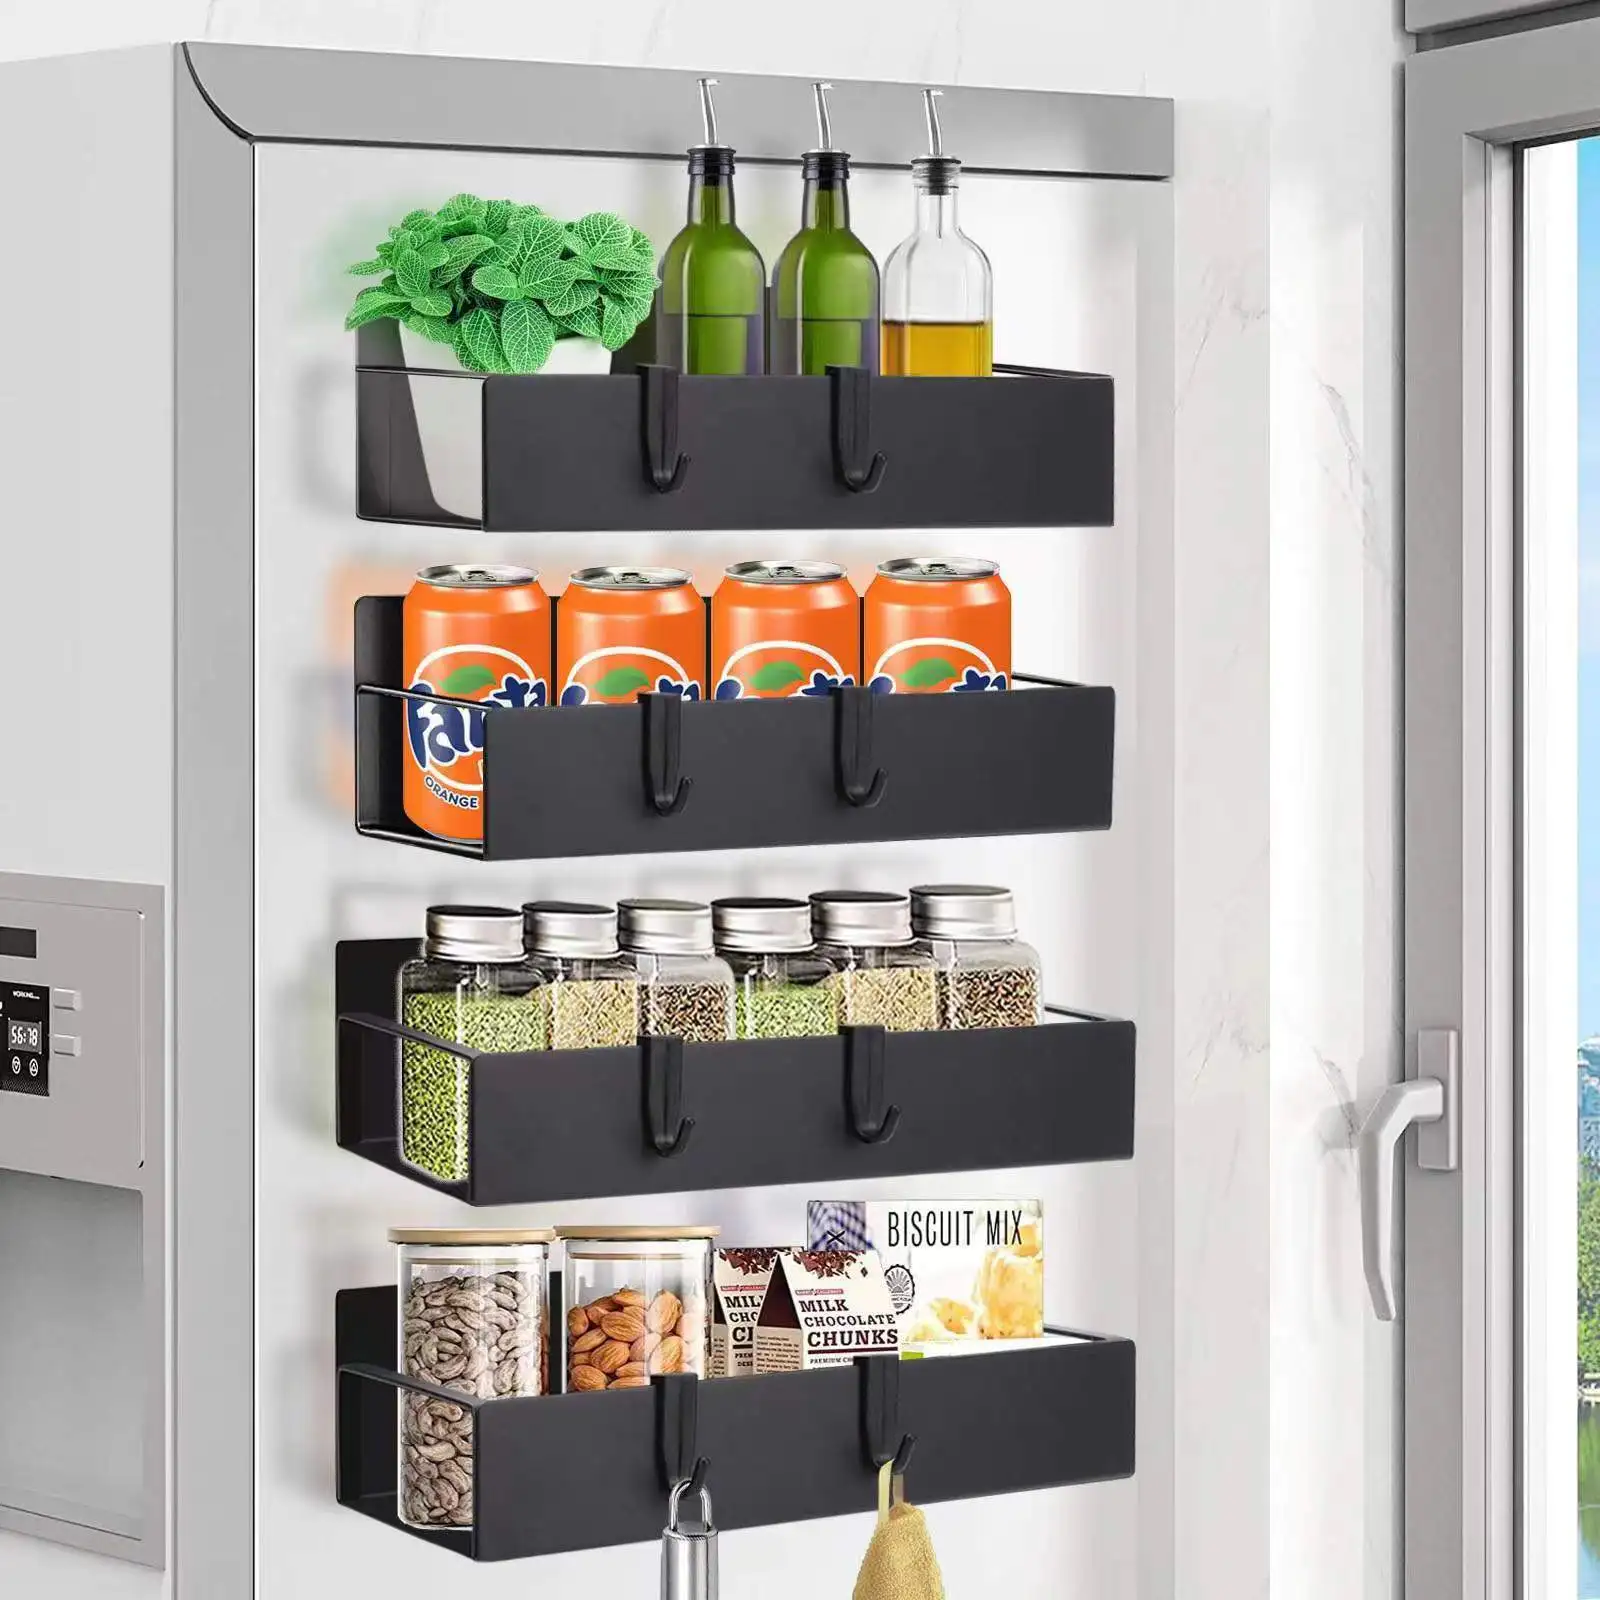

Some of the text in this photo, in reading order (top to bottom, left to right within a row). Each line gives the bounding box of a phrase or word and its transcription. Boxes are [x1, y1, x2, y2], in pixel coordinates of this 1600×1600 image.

[424, 776, 478, 808] ORANGE
[11, 1025, 38, 1046] 56:78
[888, 1210, 1022, 1247] BISCUIT MIX
[724, 1295, 764, 1308] MIL
[799, 1299, 849, 1313] MILK
[804, 1314, 896, 1328] CHOCOLATE
[807, 1328, 898, 1347] CHUNKS
